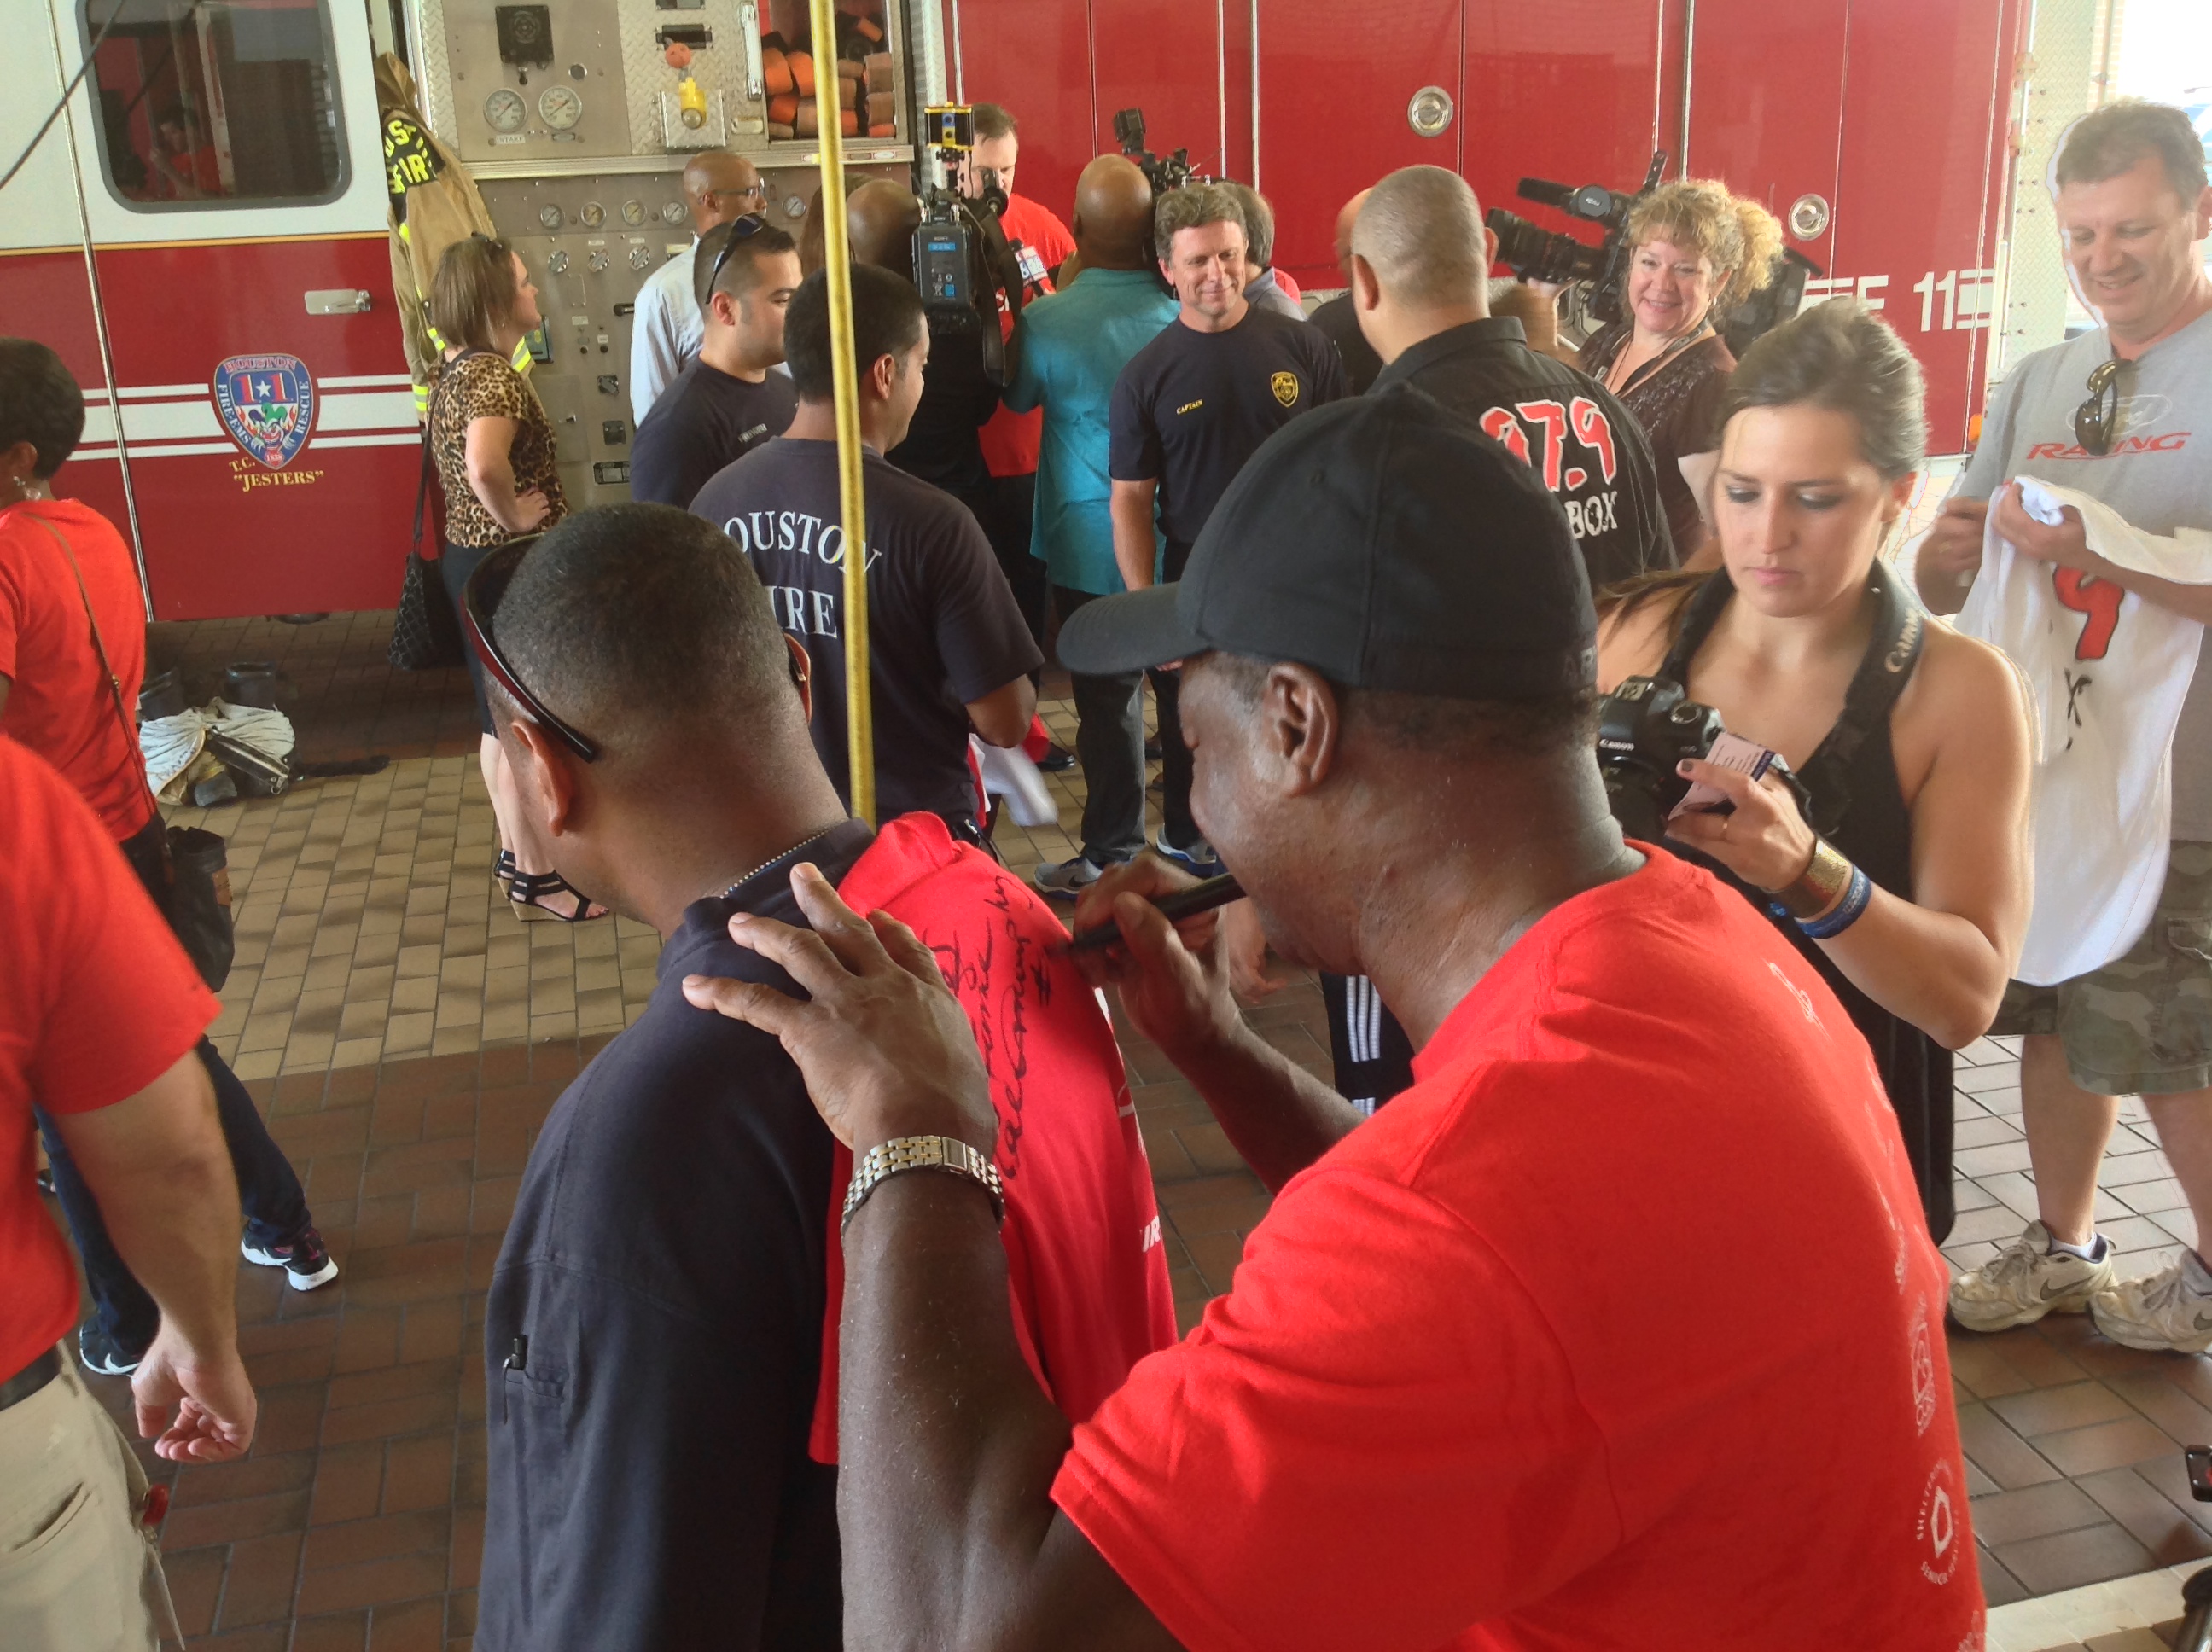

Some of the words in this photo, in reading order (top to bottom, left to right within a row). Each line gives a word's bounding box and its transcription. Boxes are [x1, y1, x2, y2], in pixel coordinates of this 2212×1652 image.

[1913, 270, 1957, 332] 11
[224, 357, 298, 374] HOUSTON
[295, 381, 311, 435] RESCUE
[1177, 399, 1203, 416] CAPTAIN
[2027, 432, 2192, 460] RAING
[229, 457, 256, 473] T.C.
[1564, 491, 1618, 539] BOX
[1599, 738, 1635, 752] Canon
